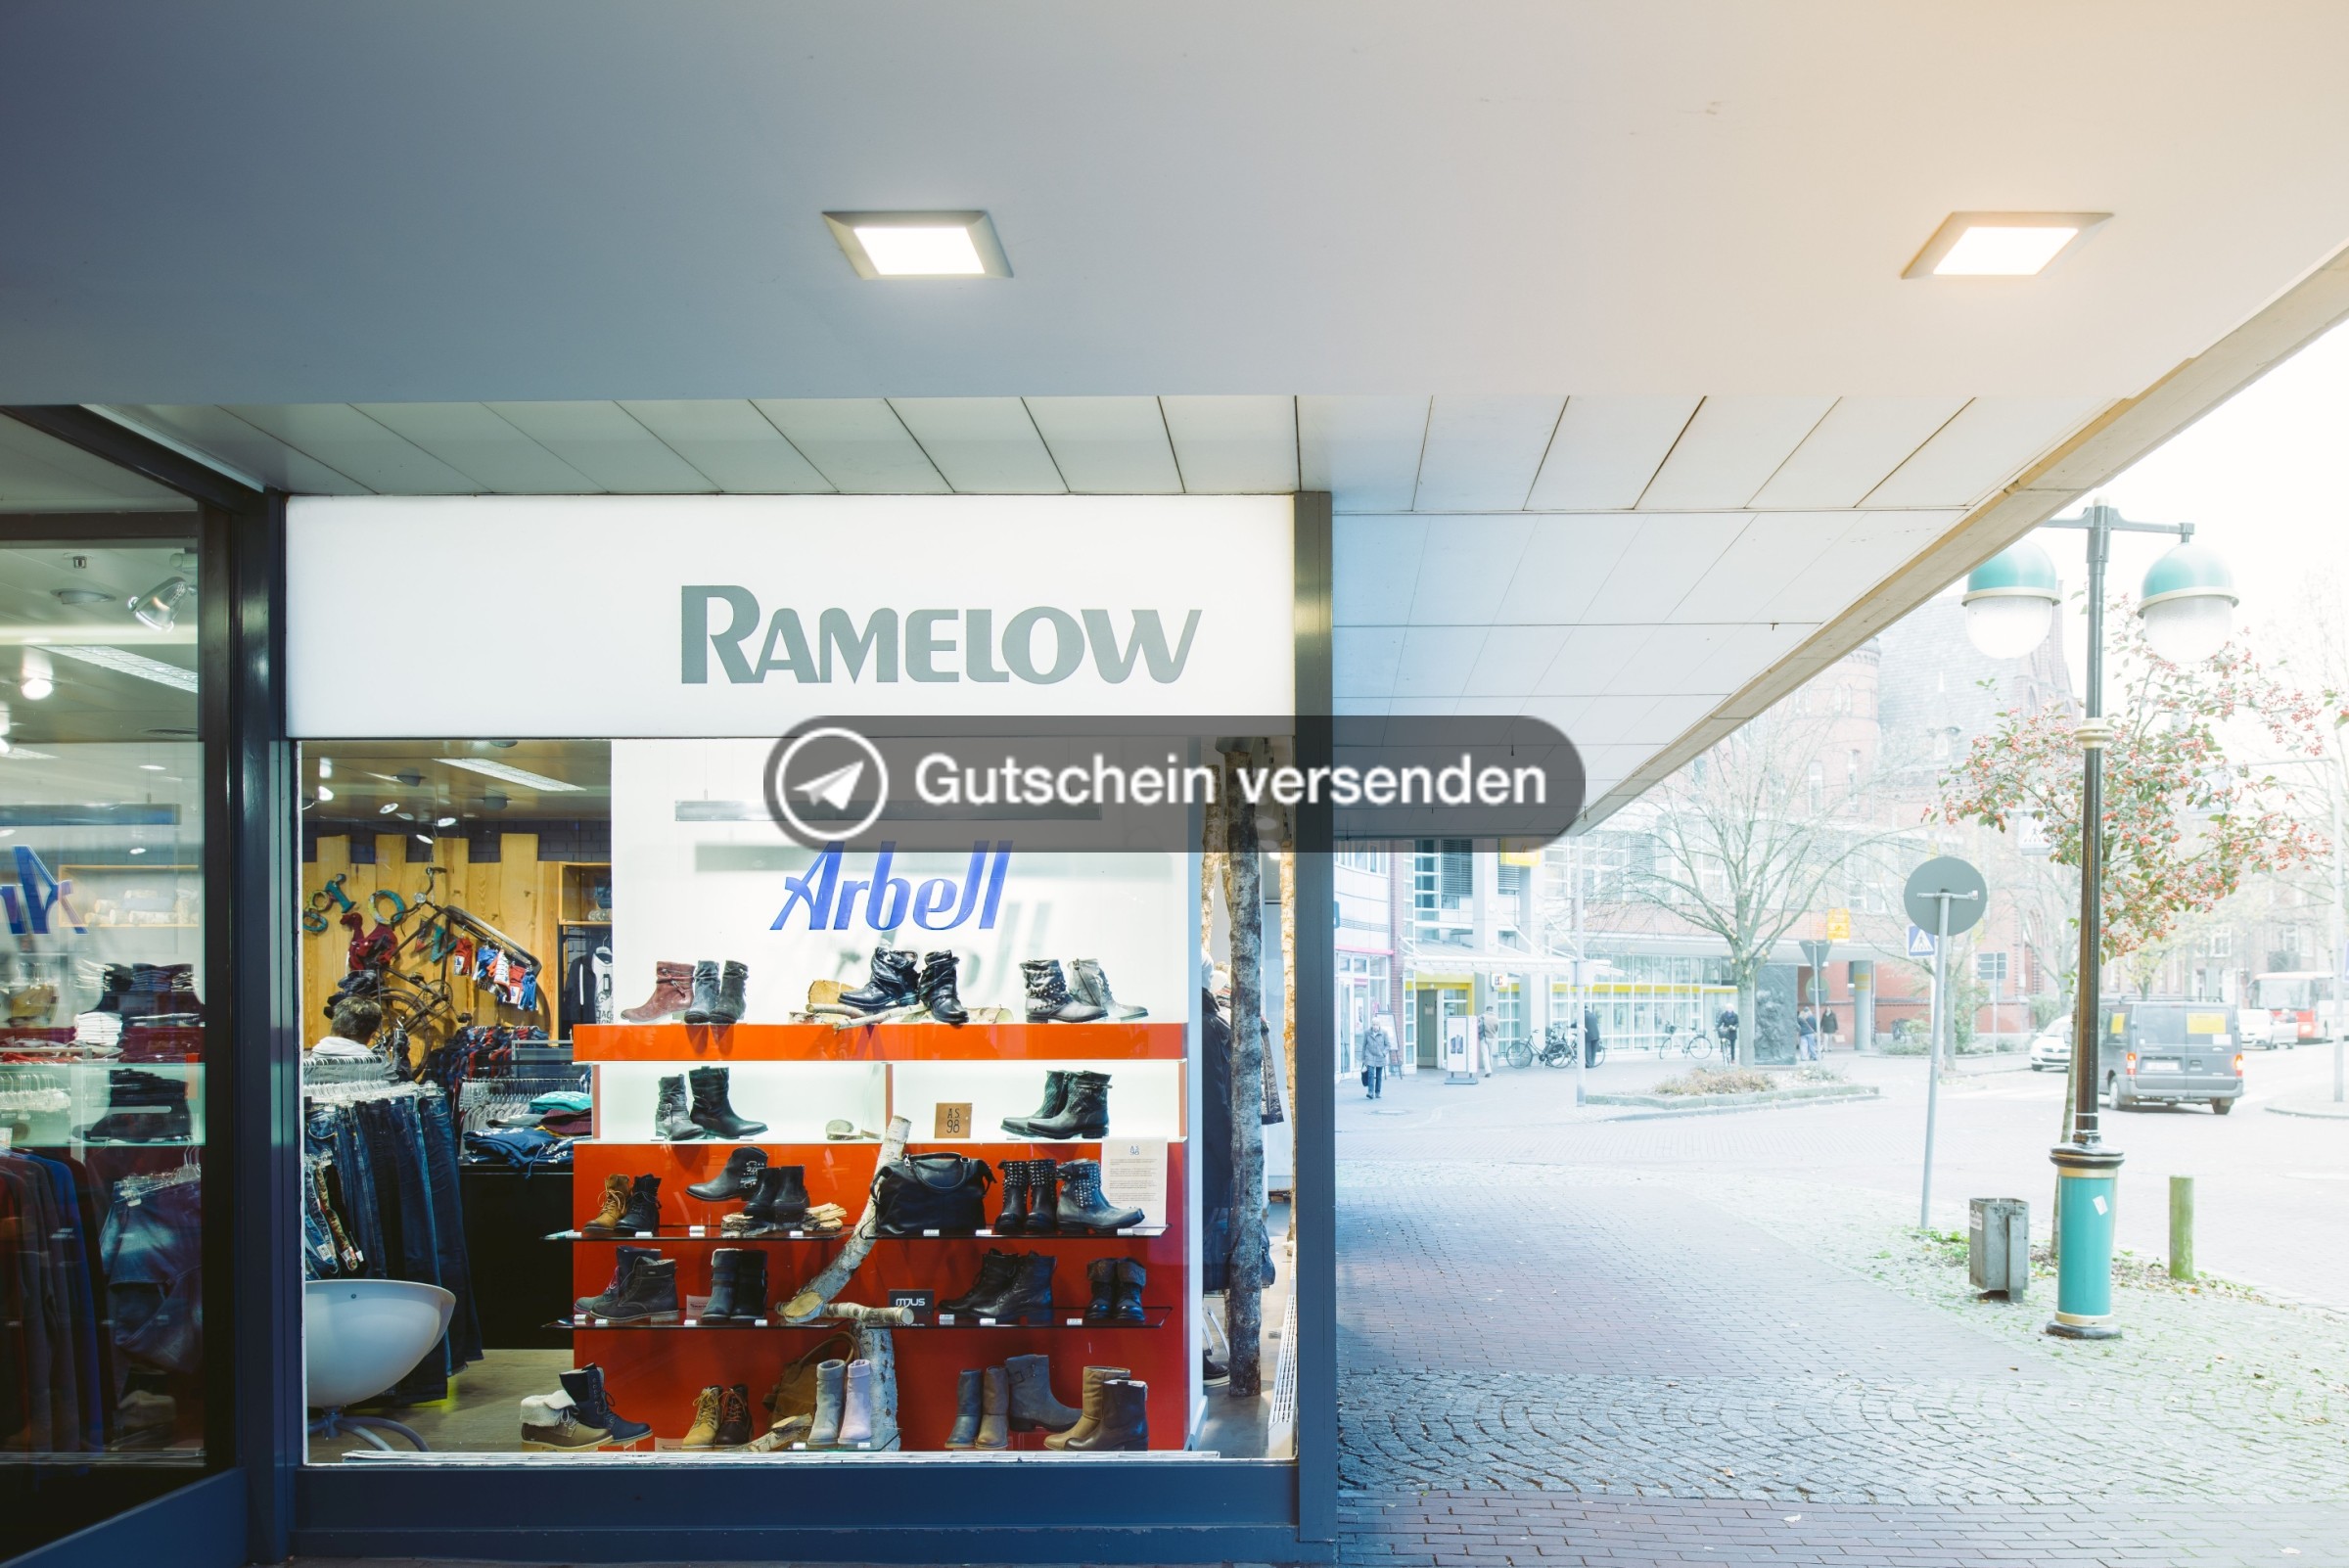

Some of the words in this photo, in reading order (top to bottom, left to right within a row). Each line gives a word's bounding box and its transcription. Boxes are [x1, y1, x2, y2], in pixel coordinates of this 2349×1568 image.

[681, 585, 1202, 685] RAMELOW
[769, 841, 1013, 931] Arbell
[946, 1119, 960, 1133] 98
